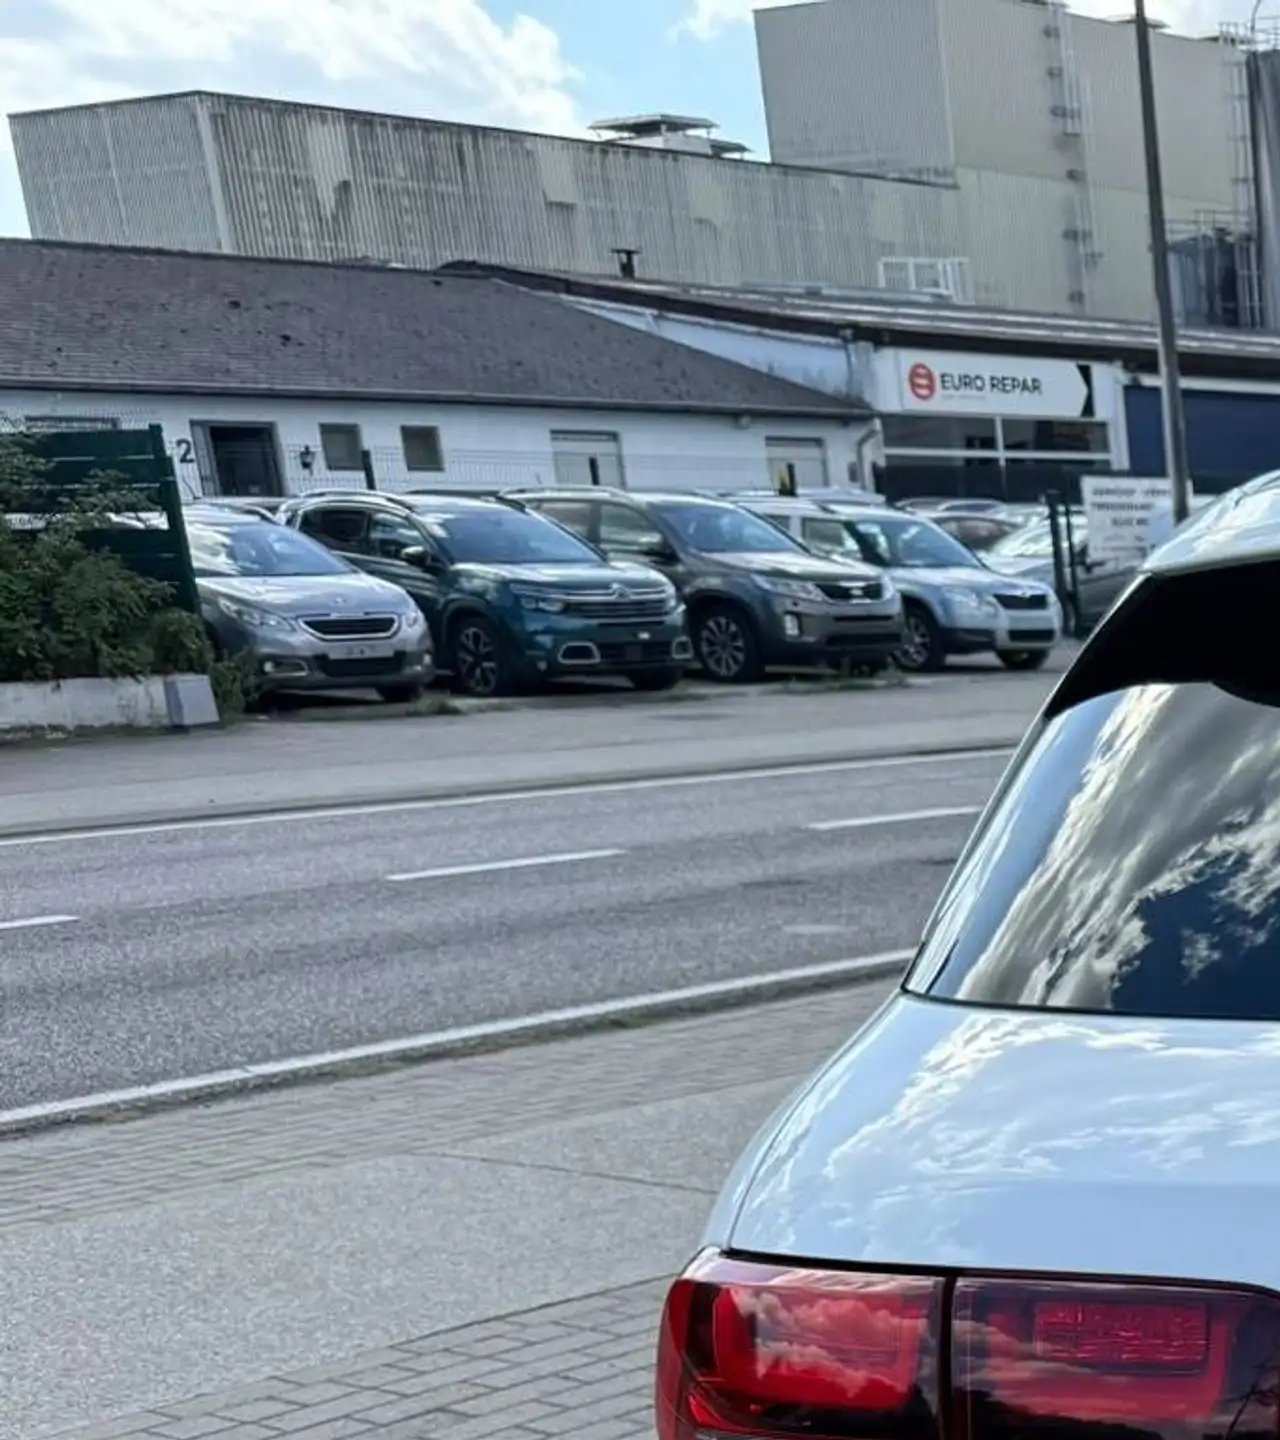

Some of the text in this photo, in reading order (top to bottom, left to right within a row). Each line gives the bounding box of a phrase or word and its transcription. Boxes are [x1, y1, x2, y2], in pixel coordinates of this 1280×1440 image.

[940, 372, 1042, 395] EURO REPAR
[175, 438, 195, 464] 2
